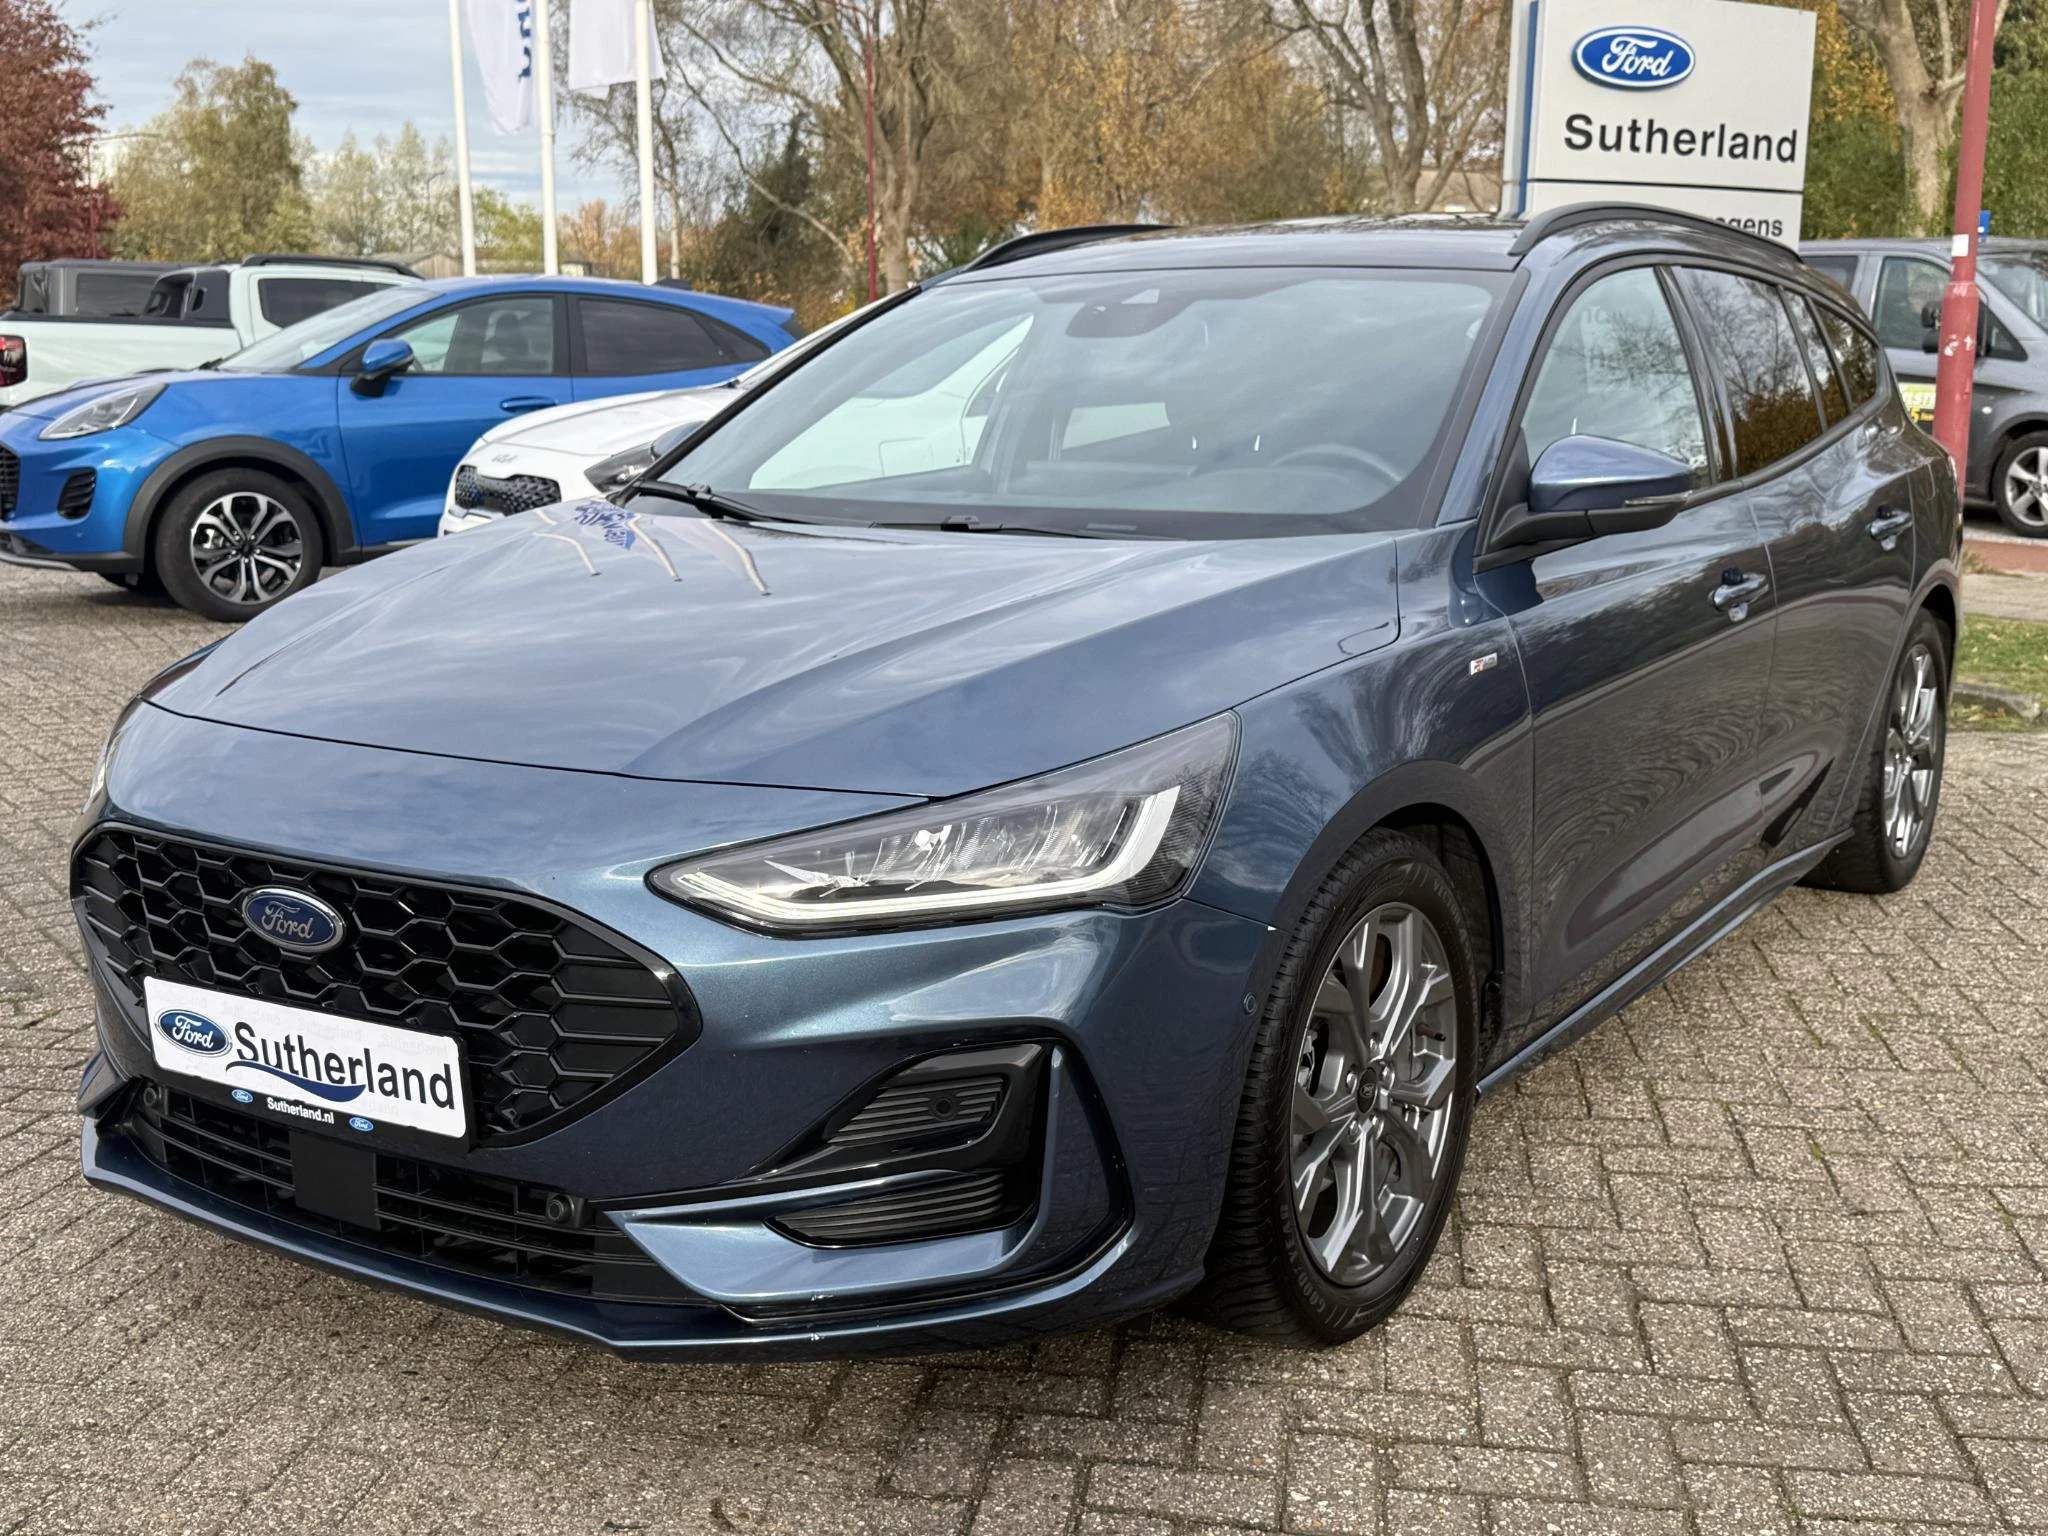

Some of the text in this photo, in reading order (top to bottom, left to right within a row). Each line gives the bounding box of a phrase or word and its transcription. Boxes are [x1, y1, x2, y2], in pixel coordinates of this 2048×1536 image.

[1601, 36, 1674, 77] Ford
[1563, 113, 1798, 164] Sutherland
[261, 900, 314, 939] Ford
[170, 1014, 215, 1049] Ford
[234, 1021, 456, 1110] Sutherland
[266, 1097, 335, 1125] Sutherland.nl
